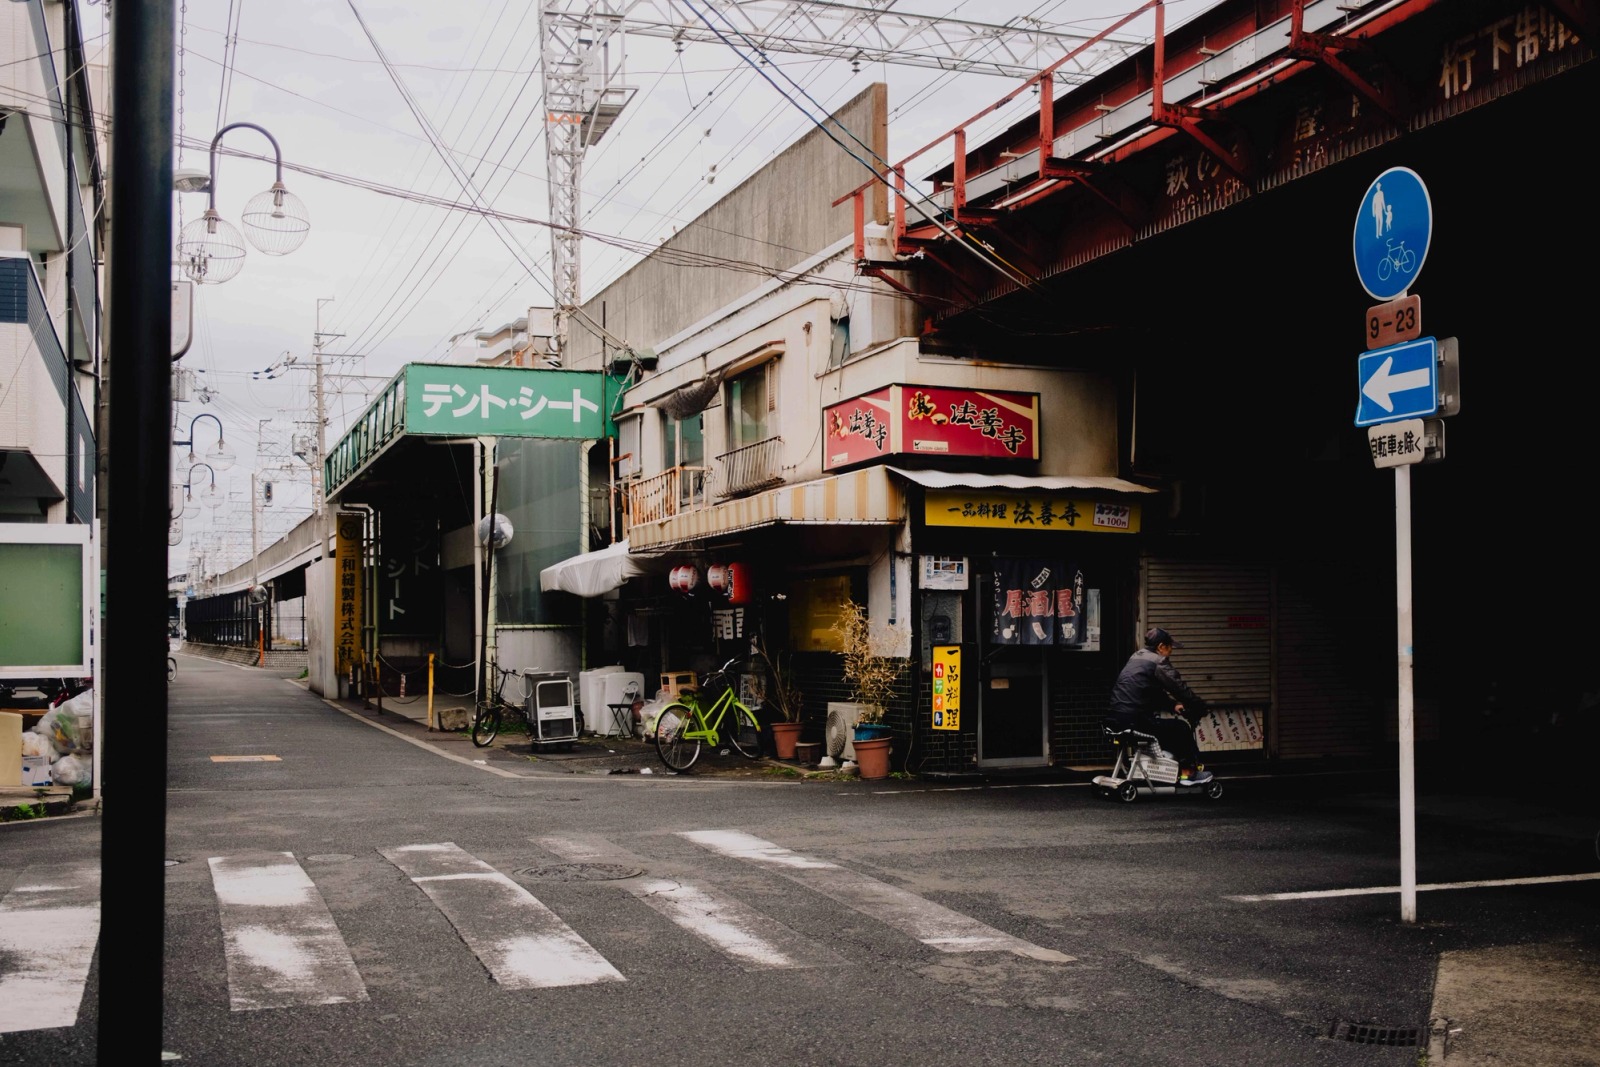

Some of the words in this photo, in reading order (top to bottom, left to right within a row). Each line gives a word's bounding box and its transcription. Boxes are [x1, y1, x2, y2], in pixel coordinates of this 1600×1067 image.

[1370, 307, 1415, 339] 9-23
[422, 383, 599, 423] テント・シート
[849, 407, 888, 452] 法善寺
[950, 400, 1026, 455] 法善寺
[1370, 430, 1421, 459] 自転車を除く
[947, 502, 1007, 519] 一品料理
[1013, 500, 1081, 526] 法善寺
[1096, 503, 1129, 517] カラオケ
[1107, 517, 1127, 527] 100円
[341, 544, 355, 661] 三和縫製株式会社
[387, 558, 405, 620] シート
[993, 570, 1002, 636] いらっしゃいませ
[1002, 589, 1076, 618] 居酒屋
[935, 663, 943, 726] カラオケ
[946, 649, 959, 727] 一品料理
